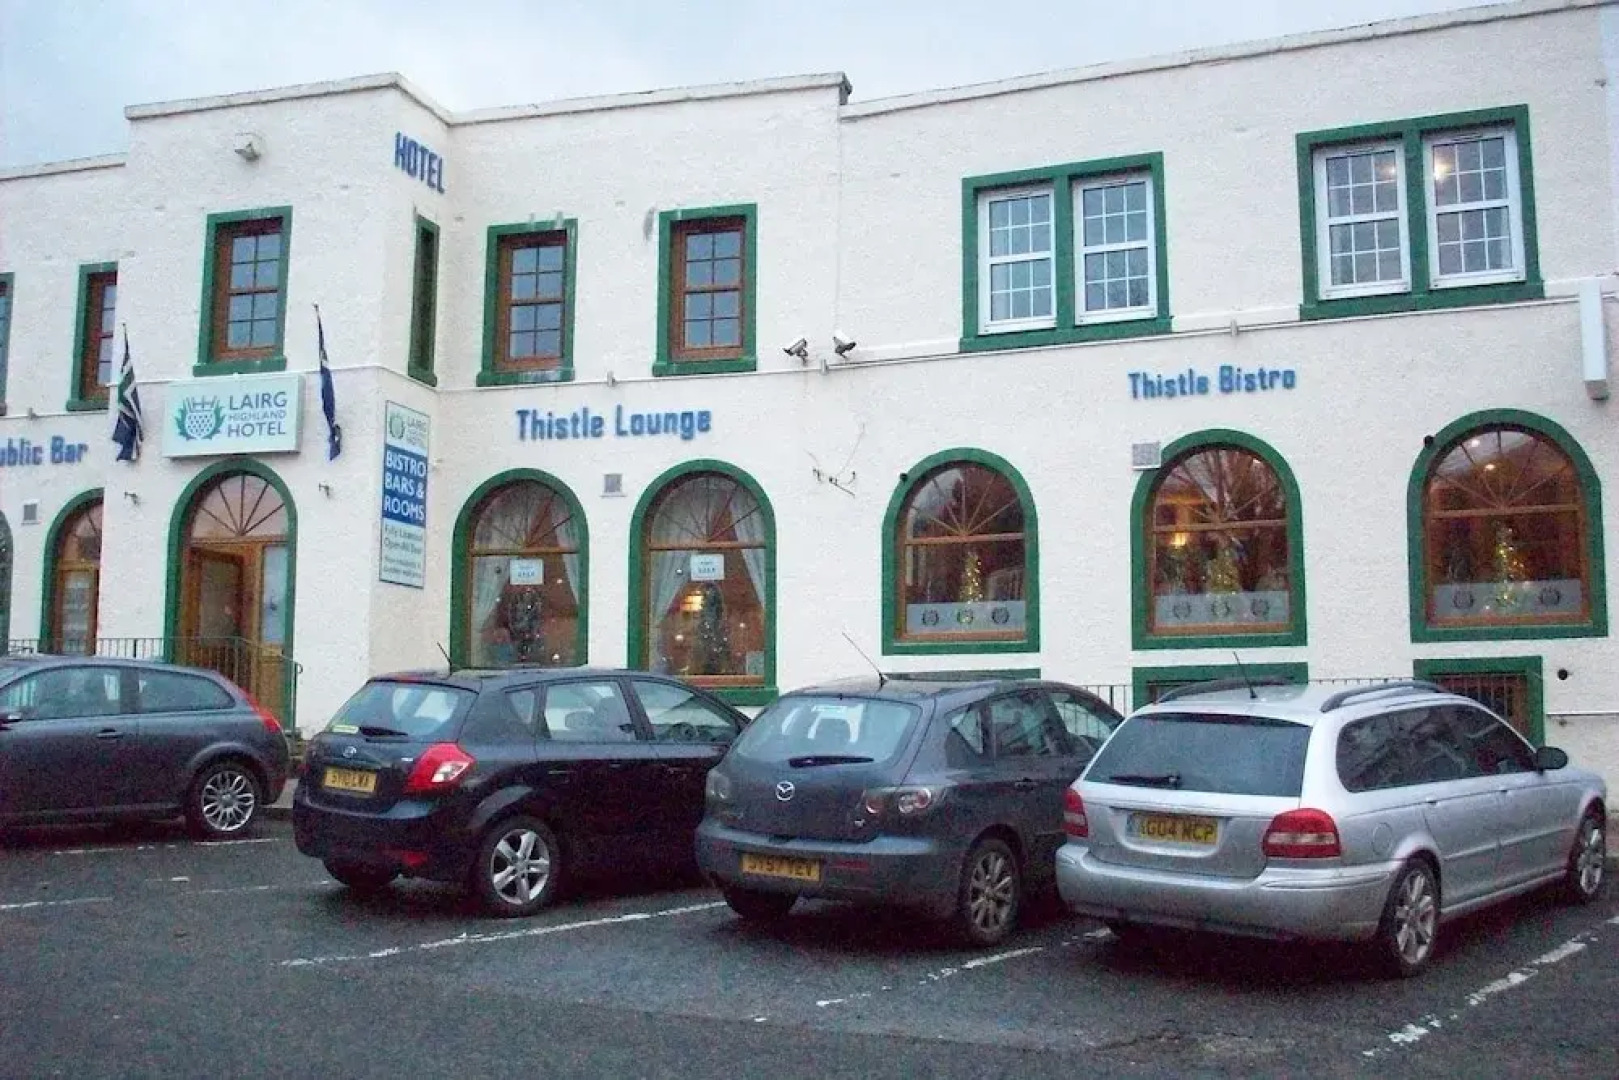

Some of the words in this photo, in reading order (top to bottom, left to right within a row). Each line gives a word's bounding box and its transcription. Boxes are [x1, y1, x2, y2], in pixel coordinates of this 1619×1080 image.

[394, 131, 444, 194] HOTEL
[1127, 368, 1209, 399] Thistle
[1218, 365, 1296, 393] Bistro
[229, 392, 288, 411] LAIRG
[229, 409, 286, 421] HIGHLAND
[228, 421, 286, 438] HOTEL
[515, 406, 604, 440] Thistle
[615, 404, 711, 440] Lounge
[51, 435, 88, 464] Bar
[386, 449, 426, 478] BISTRO
[385, 471, 415, 497] BARS
[416, 481, 424, 498] &
[384, 495, 425, 521] ROOMS
